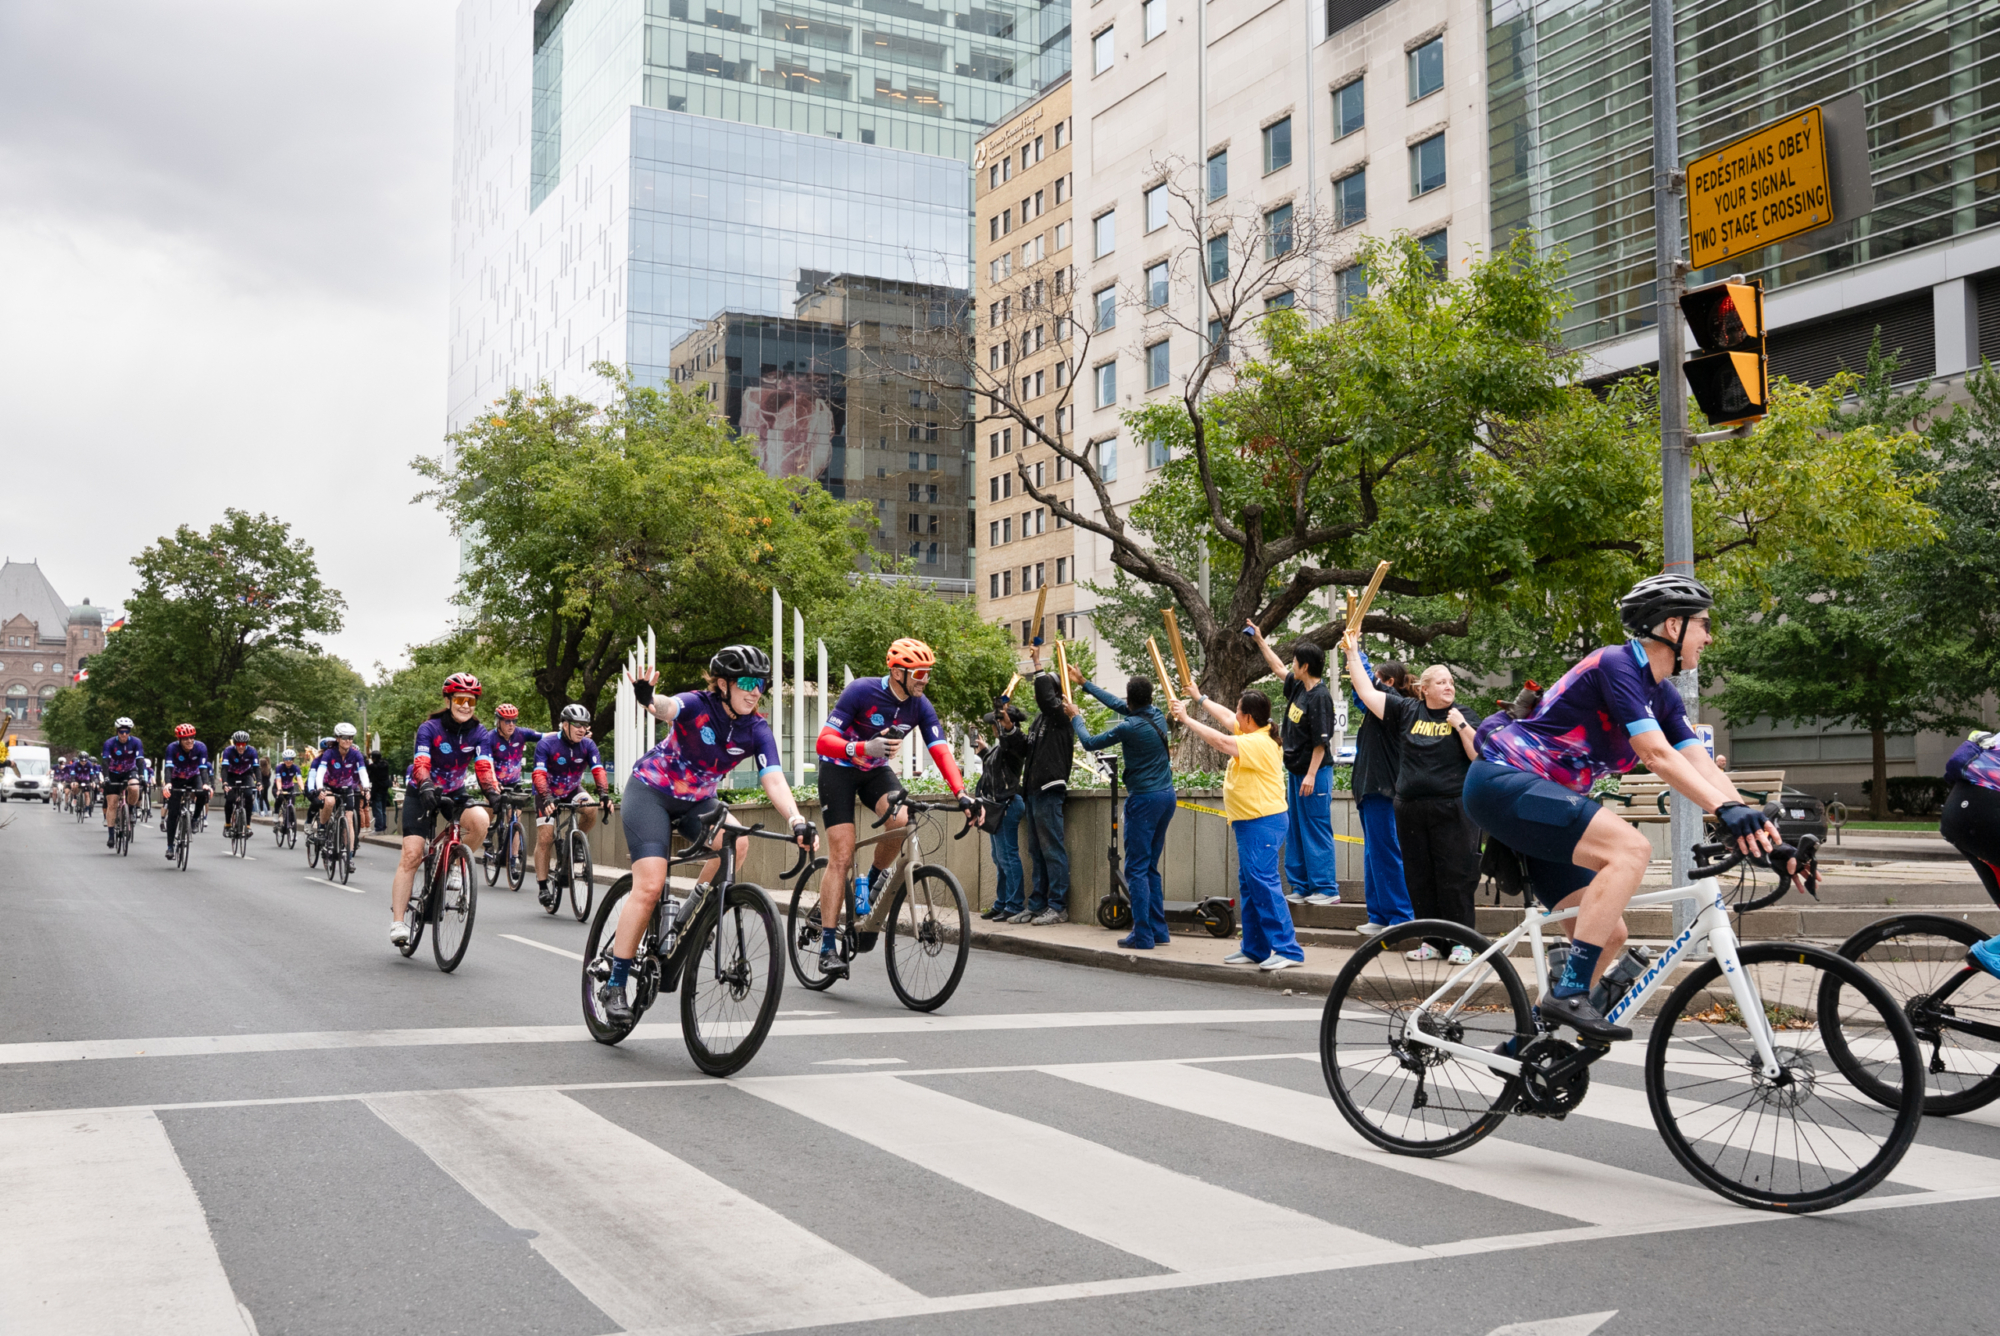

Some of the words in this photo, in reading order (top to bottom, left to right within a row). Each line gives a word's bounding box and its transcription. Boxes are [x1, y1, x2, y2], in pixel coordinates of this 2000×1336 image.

[1695, 145, 1774, 196] PEDESTRIANS
[1778, 128, 1811, 160] OBEY
[1714, 186, 1747, 215] YOUR
[1751, 167, 1796, 201] SIGNAL
[1694, 227, 1717, 252] TWO
[1721, 210, 1758, 242] STAGE
[1762, 185, 1824, 226] CROSSING
